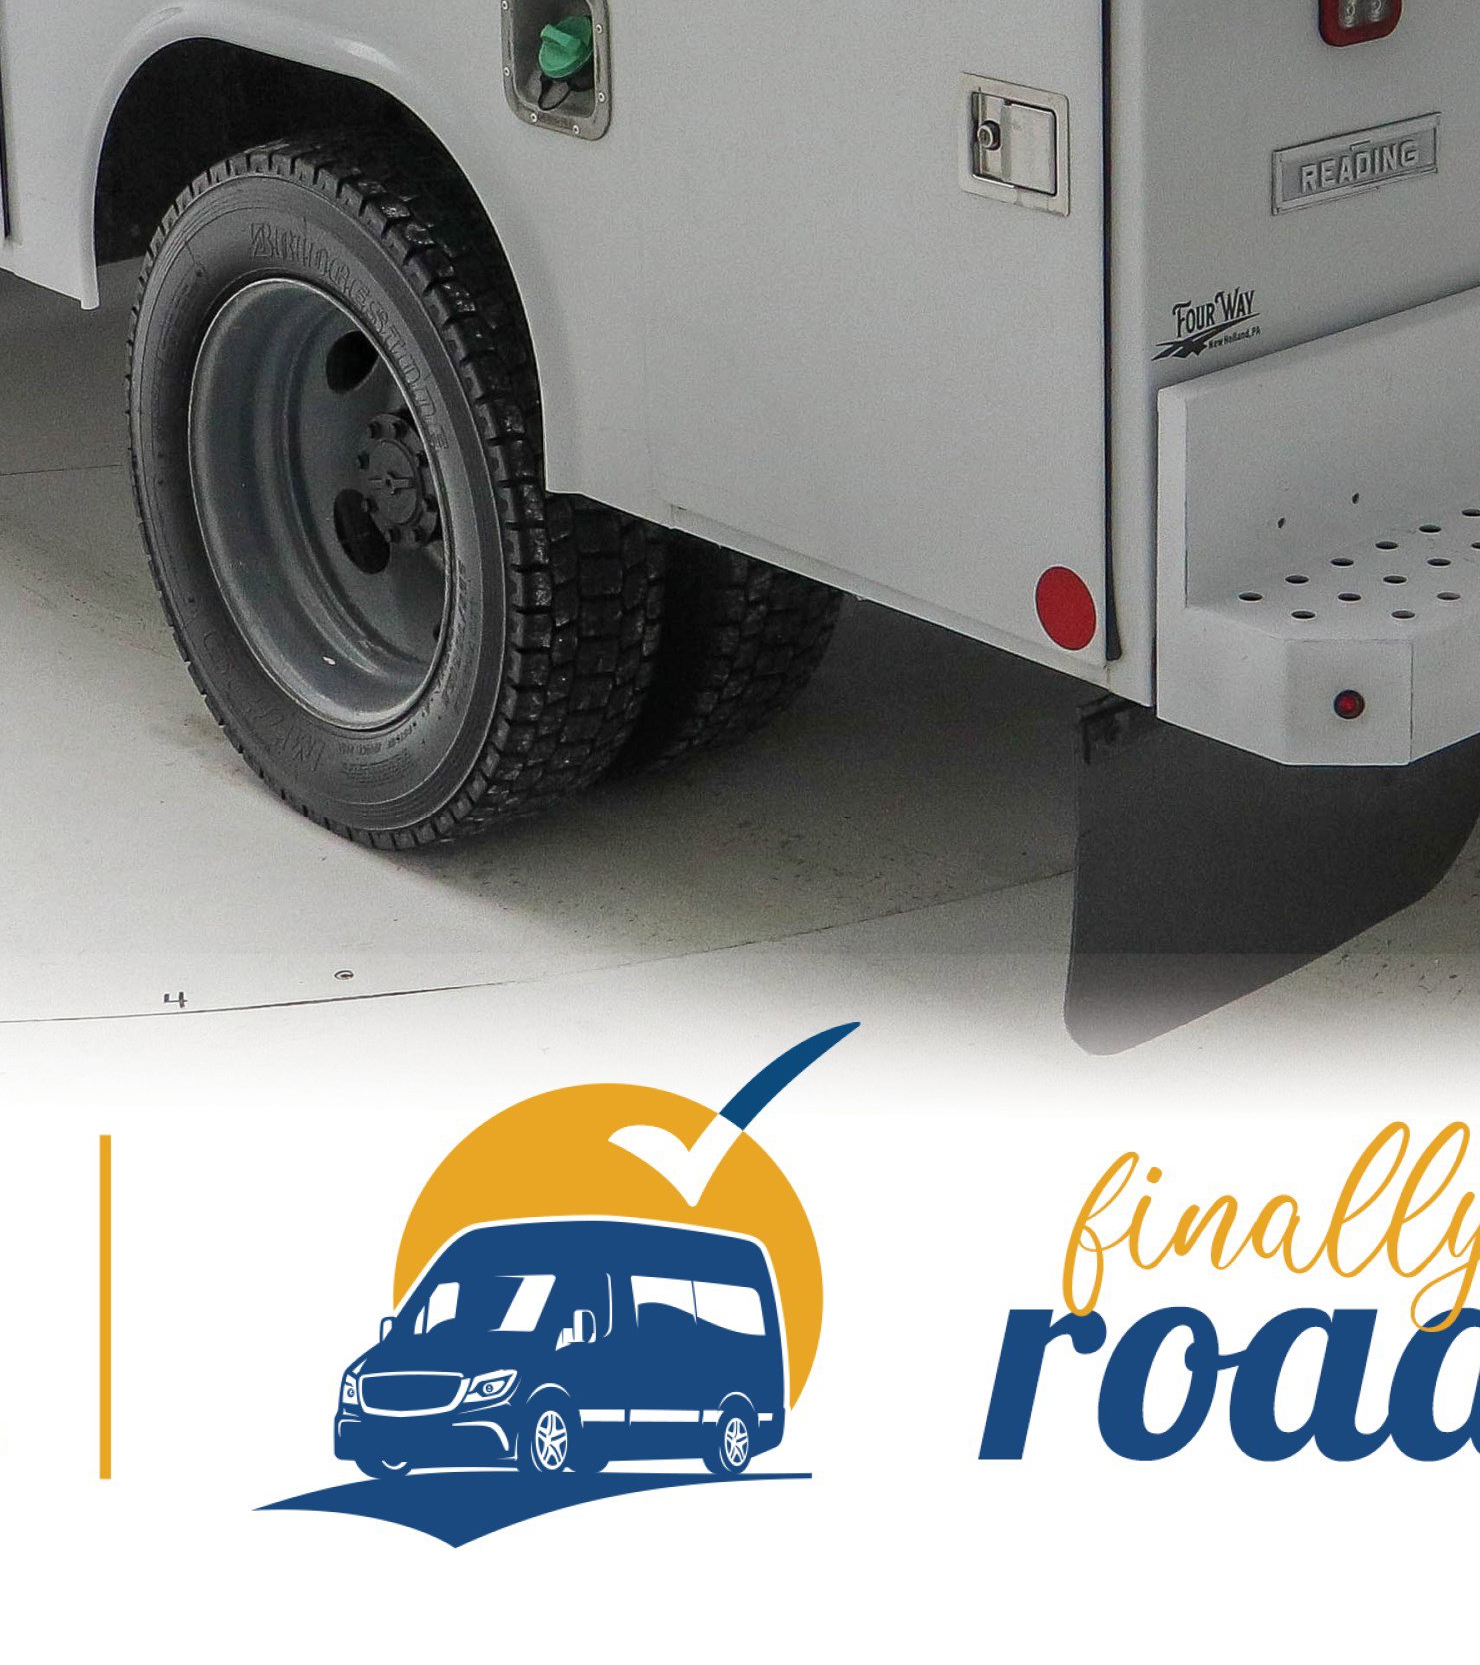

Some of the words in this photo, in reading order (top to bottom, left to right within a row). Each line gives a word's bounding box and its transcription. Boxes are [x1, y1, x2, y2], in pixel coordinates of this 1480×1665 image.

[1301, 139, 1419, 194] READING
[1172, 300, 1216, 338] FOUR
[1215, 286, 1255, 322] WAY
